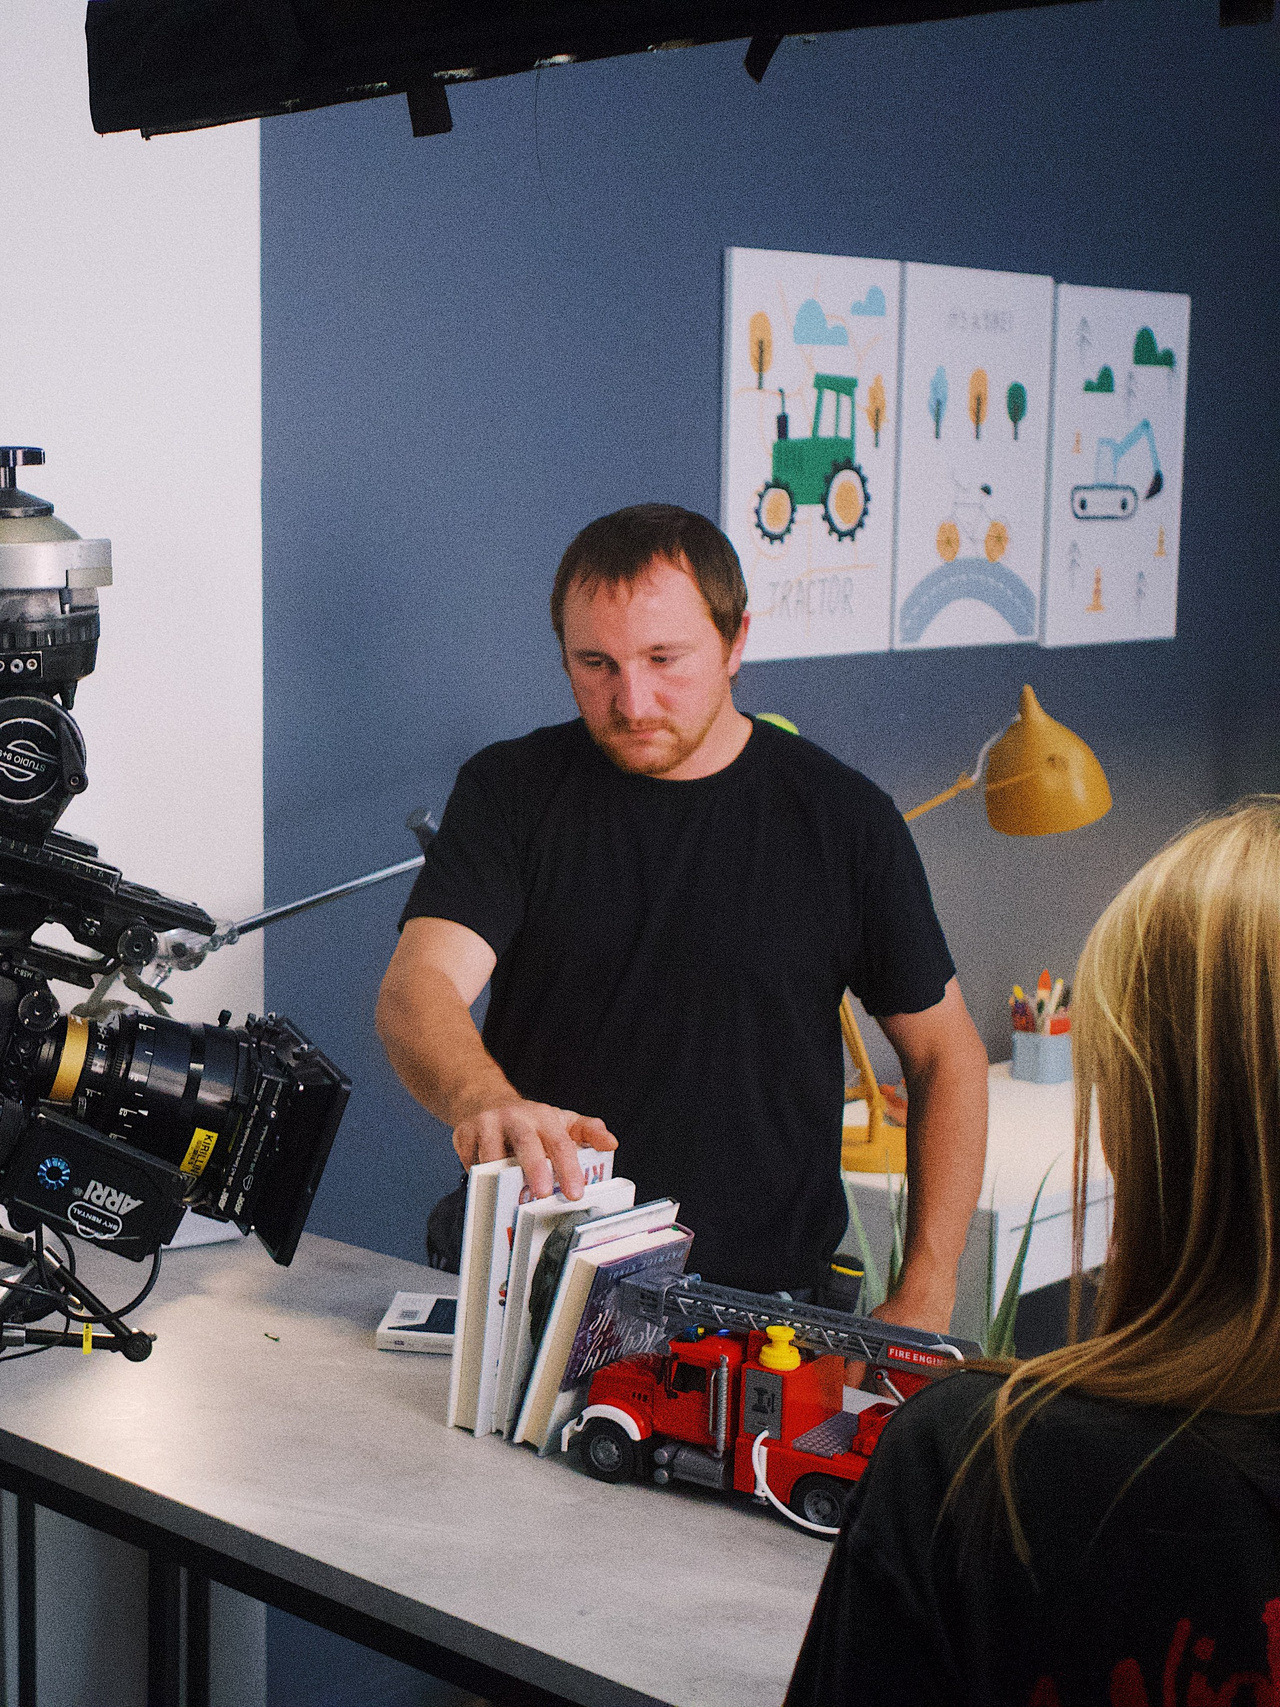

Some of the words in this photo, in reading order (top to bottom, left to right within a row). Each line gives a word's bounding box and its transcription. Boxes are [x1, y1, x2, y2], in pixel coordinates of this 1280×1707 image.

[767, 574, 855, 619] TRACTOR
[13, 755, 46, 772] STUDIO
[83, 1179, 144, 1215] ARRI
[72, 1206, 102, 1224] RENTAL
[102, 1217, 119, 1230] SKY
[889, 1348, 911, 1359] FIRE
[912, 1353, 944, 1366] ENGIN
